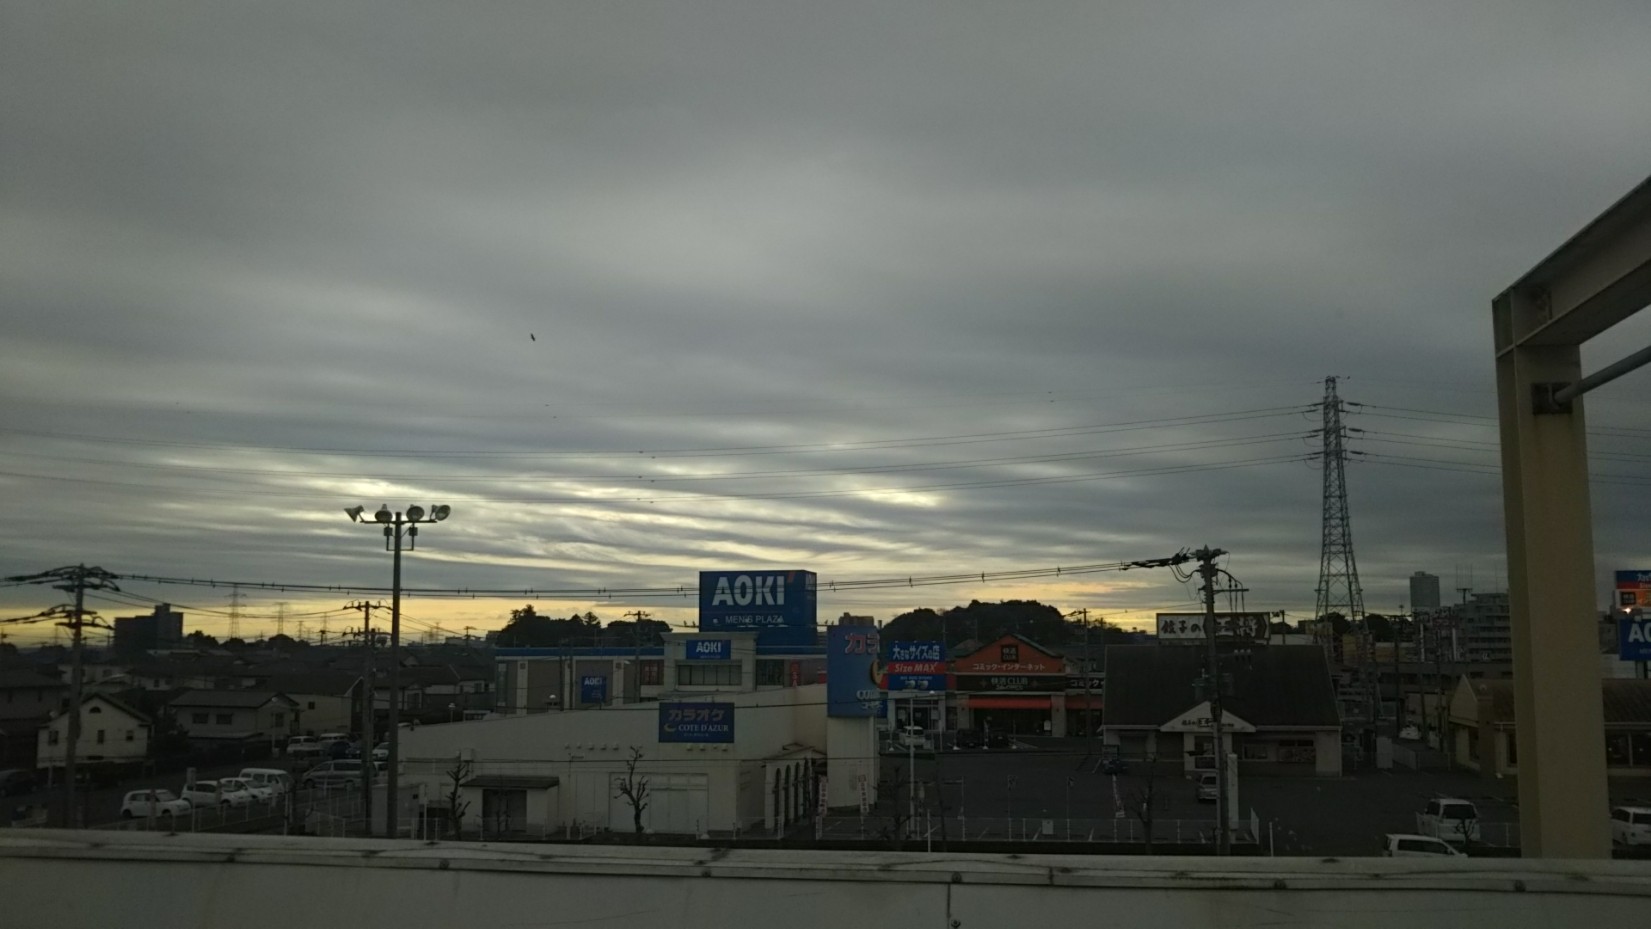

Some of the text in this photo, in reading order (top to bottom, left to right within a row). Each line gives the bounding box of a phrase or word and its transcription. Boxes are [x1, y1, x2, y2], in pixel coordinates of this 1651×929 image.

[712, 575, 785, 606] AOKI
[756, 615, 784, 624] PLAZA
[696, 641, 722, 653] AOKI
[895, 662, 937, 672] Size MAX
[669, 709, 724, 721] カラオケ
